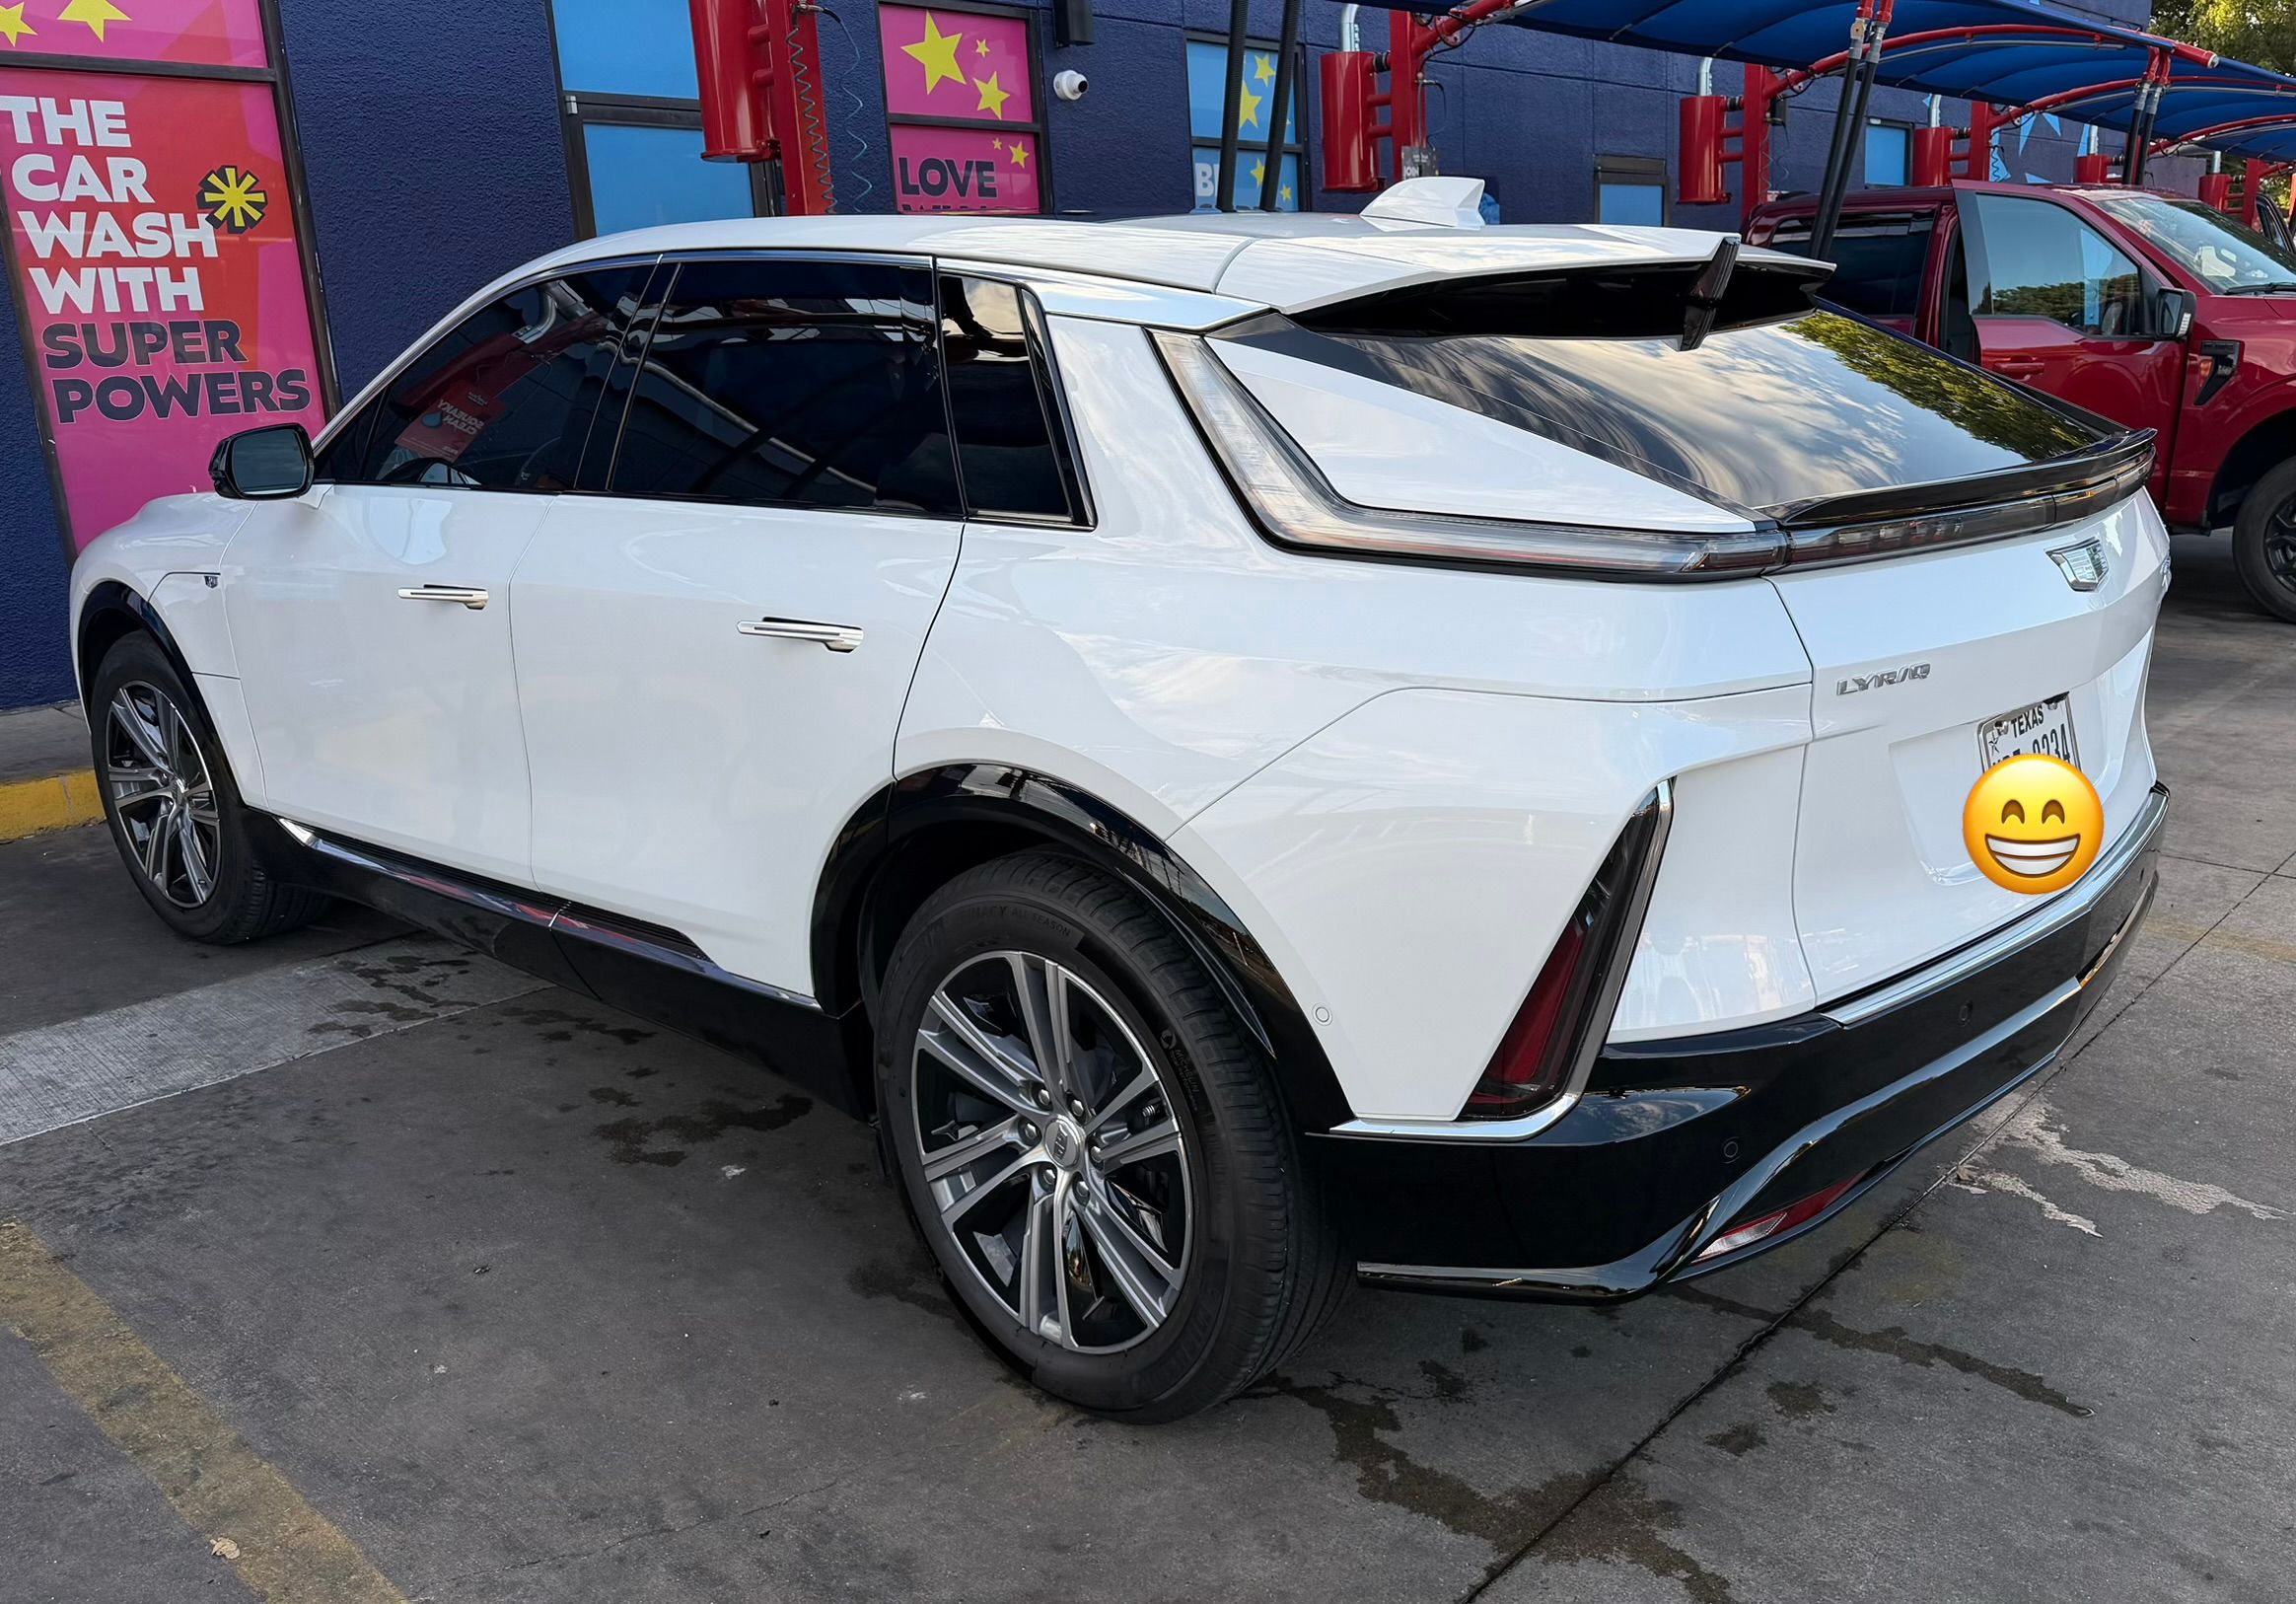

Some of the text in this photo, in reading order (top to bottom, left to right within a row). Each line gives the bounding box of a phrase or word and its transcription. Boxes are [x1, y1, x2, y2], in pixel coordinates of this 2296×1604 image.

[0, 96, 131, 148] THE
[11, 155, 155, 204] CAR
[897, 157, 998, 198] LOVE
[18, 210, 219, 258] WASH
[29, 266, 204, 315] WITH
[42, 319, 250, 371] SUPER
[51, 369, 312, 425] POWERS
[2011, 704, 2045, 738] TEXAS
